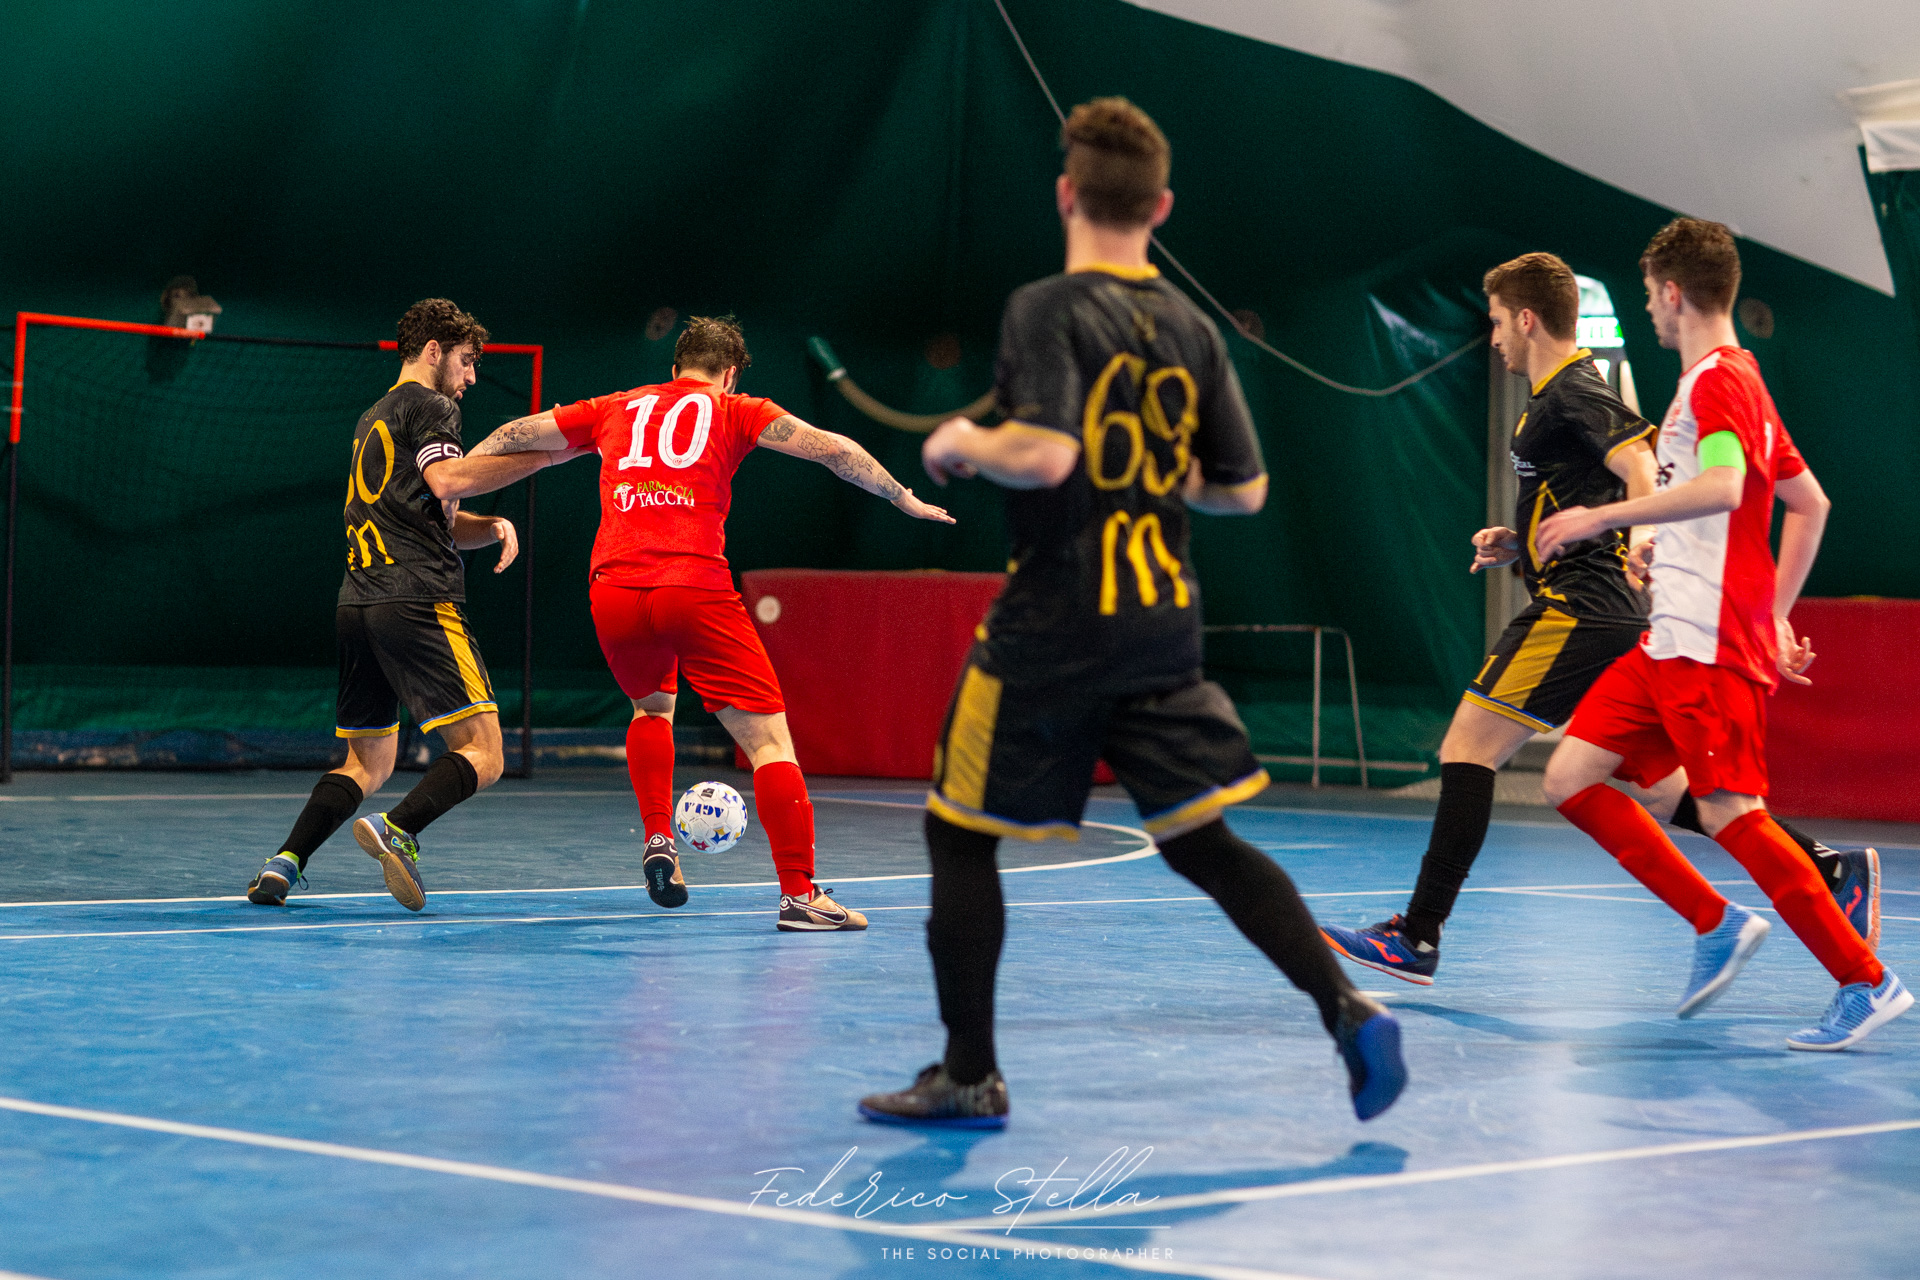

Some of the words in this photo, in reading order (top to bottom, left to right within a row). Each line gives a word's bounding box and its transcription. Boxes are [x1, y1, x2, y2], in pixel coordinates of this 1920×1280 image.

[618, 393, 713, 471] 10
[1083, 352, 1199, 495] 69
[636, 480, 694, 498] FARMACIA
[636, 490, 695, 507] TACCHI
